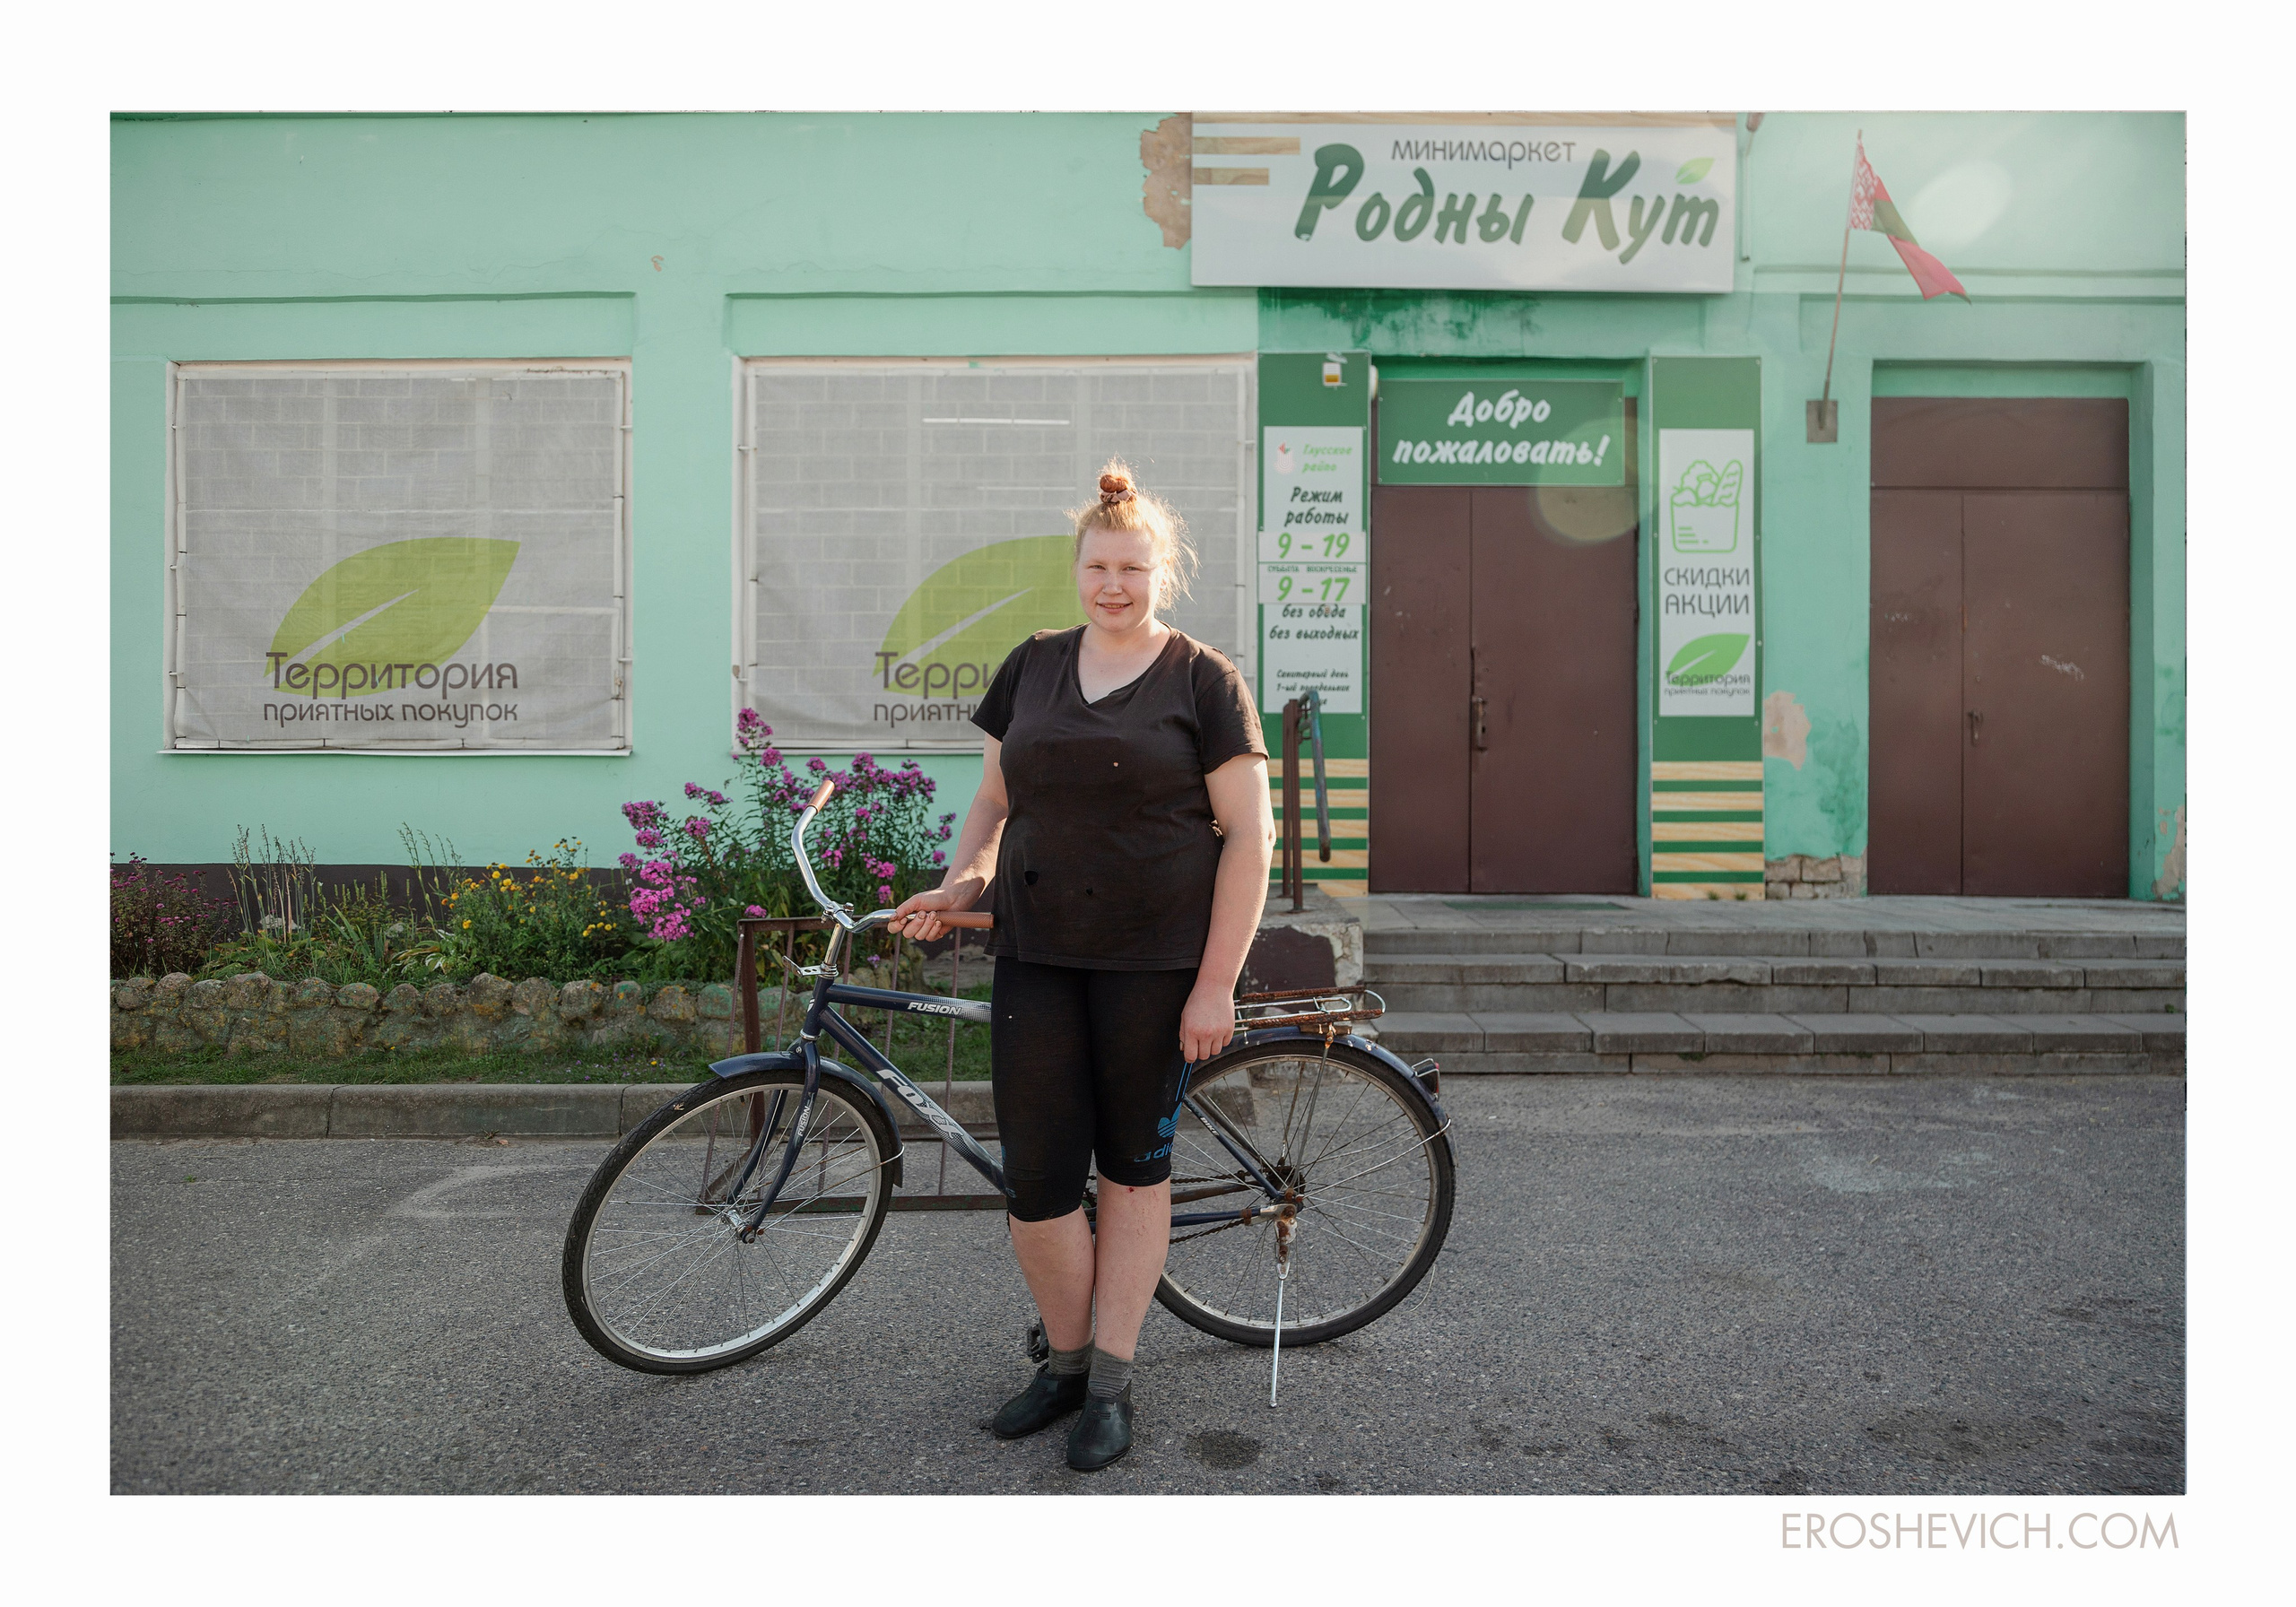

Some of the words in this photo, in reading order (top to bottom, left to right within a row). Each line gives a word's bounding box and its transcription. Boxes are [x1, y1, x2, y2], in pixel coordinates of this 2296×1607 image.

[1391, 140, 1577, 169] минимаркет
[1294, 143, 1535, 245] Родны
[1561, 148, 1719, 265] Кут
[1447, 389, 1552, 430] Добро
[1392, 434, 1611, 467] пожаловать!
[1290, 485, 1343, 503] Режим
[1284, 507, 1349, 527] работы
[1278, 532, 1292, 559] 9
[1323, 532, 1351, 559] 19
[1277, 576, 1293, 602] 9
[1320, 577, 1351, 602] 17
[1665, 567, 1750, 589] СКИДКИ
[1282, 604, 1303, 618] без
[1309, 604, 1346, 618] обеда
[1665, 593, 1750, 619] АКЦИИ
[1269, 625, 1291, 639] без
[1296, 625, 1360, 640] выходных
[265, 651, 518, 699] Территория
[1665, 670, 1751, 688] Территория
[264, 703, 394, 728] приятных
[402, 703, 518, 728] покупок
[874, 704, 977, 728] приятн
[908, 1002, 963, 1016] FUSION
[797, 1105, 812, 1137] FUSION
